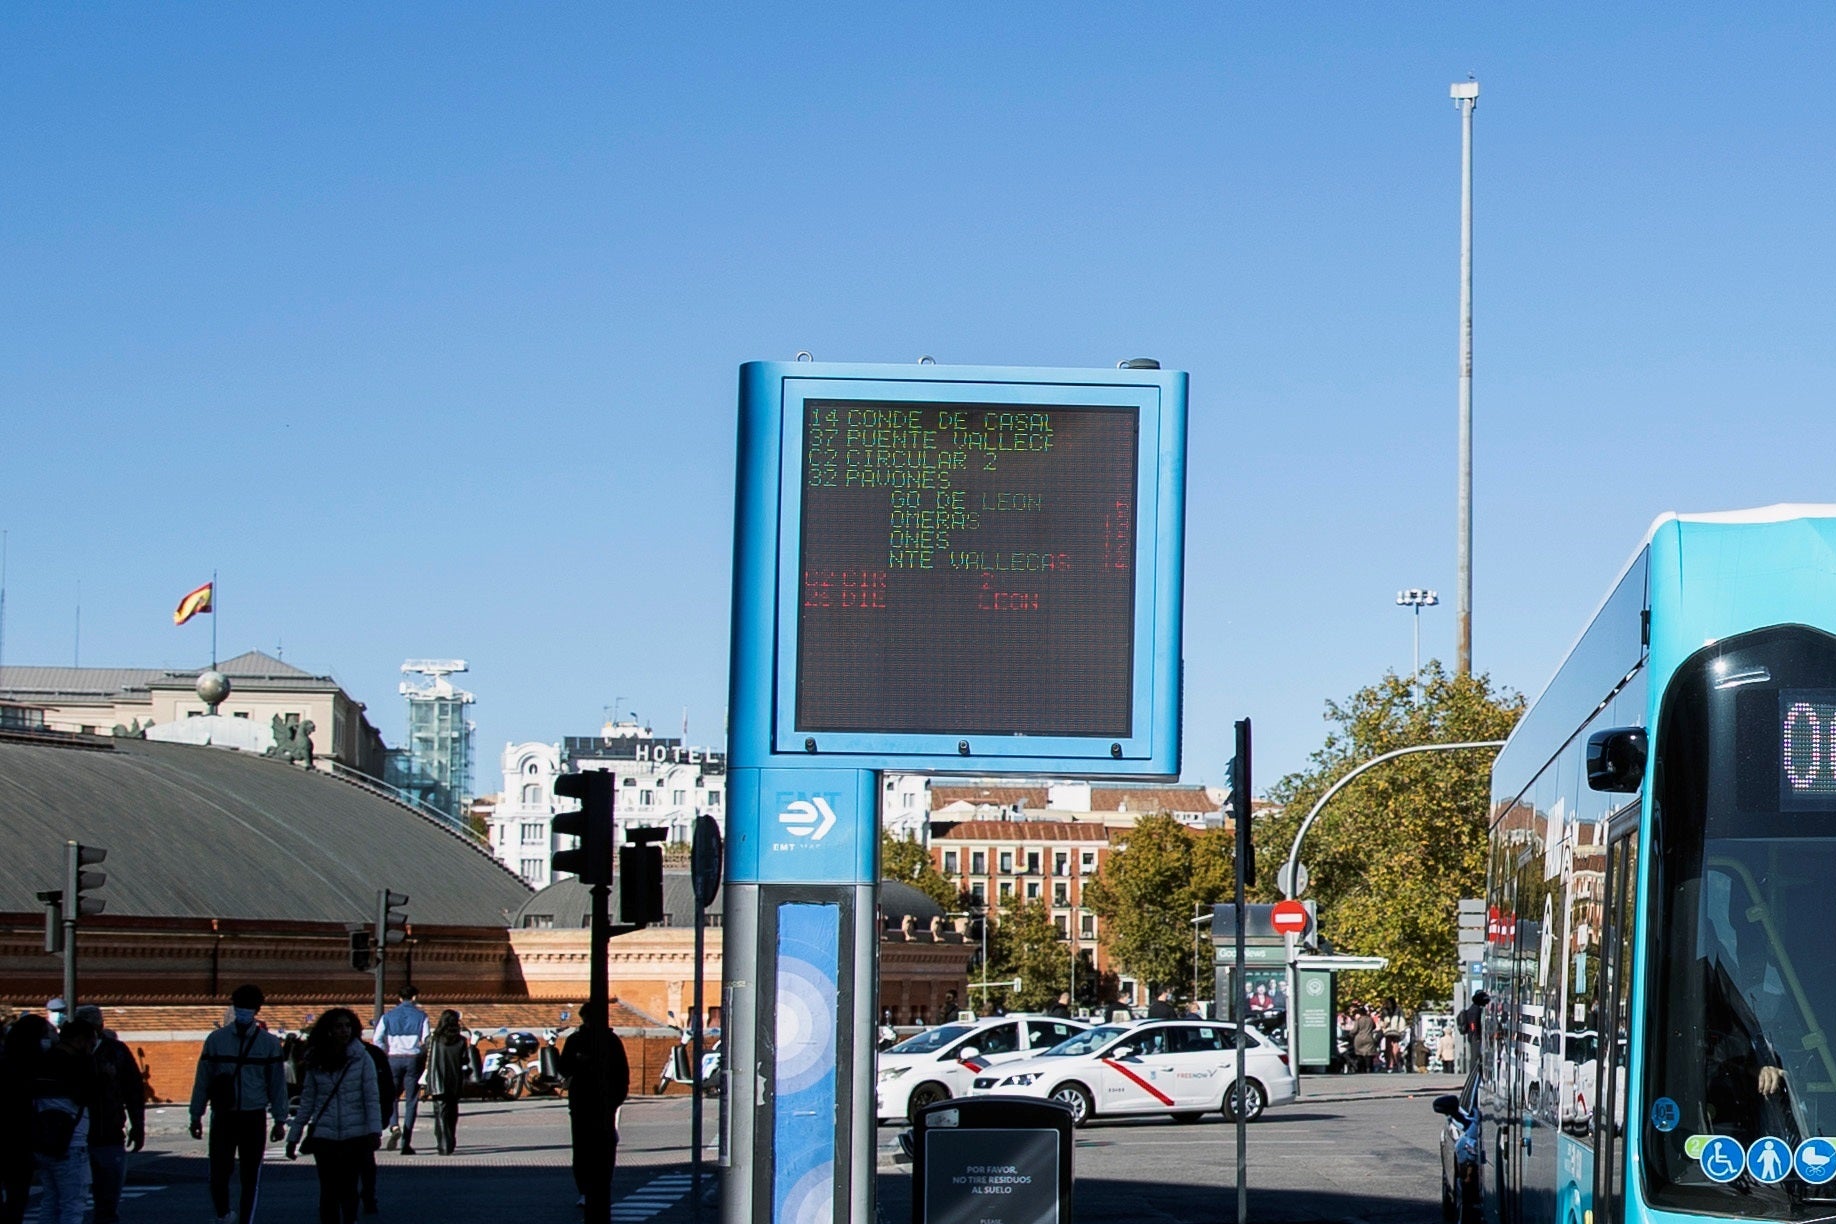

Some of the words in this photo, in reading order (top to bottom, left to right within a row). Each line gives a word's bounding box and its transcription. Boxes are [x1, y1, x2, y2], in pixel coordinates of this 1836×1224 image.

[808, 408, 839, 427] 14
[847, 409, 923, 429] CONDE
[939, 411, 967, 430] DE
[984, 412, 1054, 432] CASAL
[808, 429, 839, 447] 37
[846, 429, 937, 450] PUENTE
[808, 448, 838, 467] C2
[846, 449, 967, 470] CIRCULAR
[983, 452, 997, 471] 2
[808, 468, 838, 487] 32
[845, 469, 952, 490] PAVONES
[936, 490, 966, 510] DE
[982, 492, 1041, 512] LEON
[890, 510, 980, 530] OMERAS
[889, 530, 950, 550] ONES
[888, 549, 934, 569] NTE
[635, 744, 719, 764] HOTEL
[772, 843, 796, 851] EMT
[952, 1176, 967, 1184] NO
[968, 1176, 987, 1184] TIRE
[988, 1176, 1032, 1184] RESIDUOS
[966, 1166, 985, 1174] POR
[971, 1186, 983, 1194] AL
[983, 1186, 1012, 1194] SUELO
